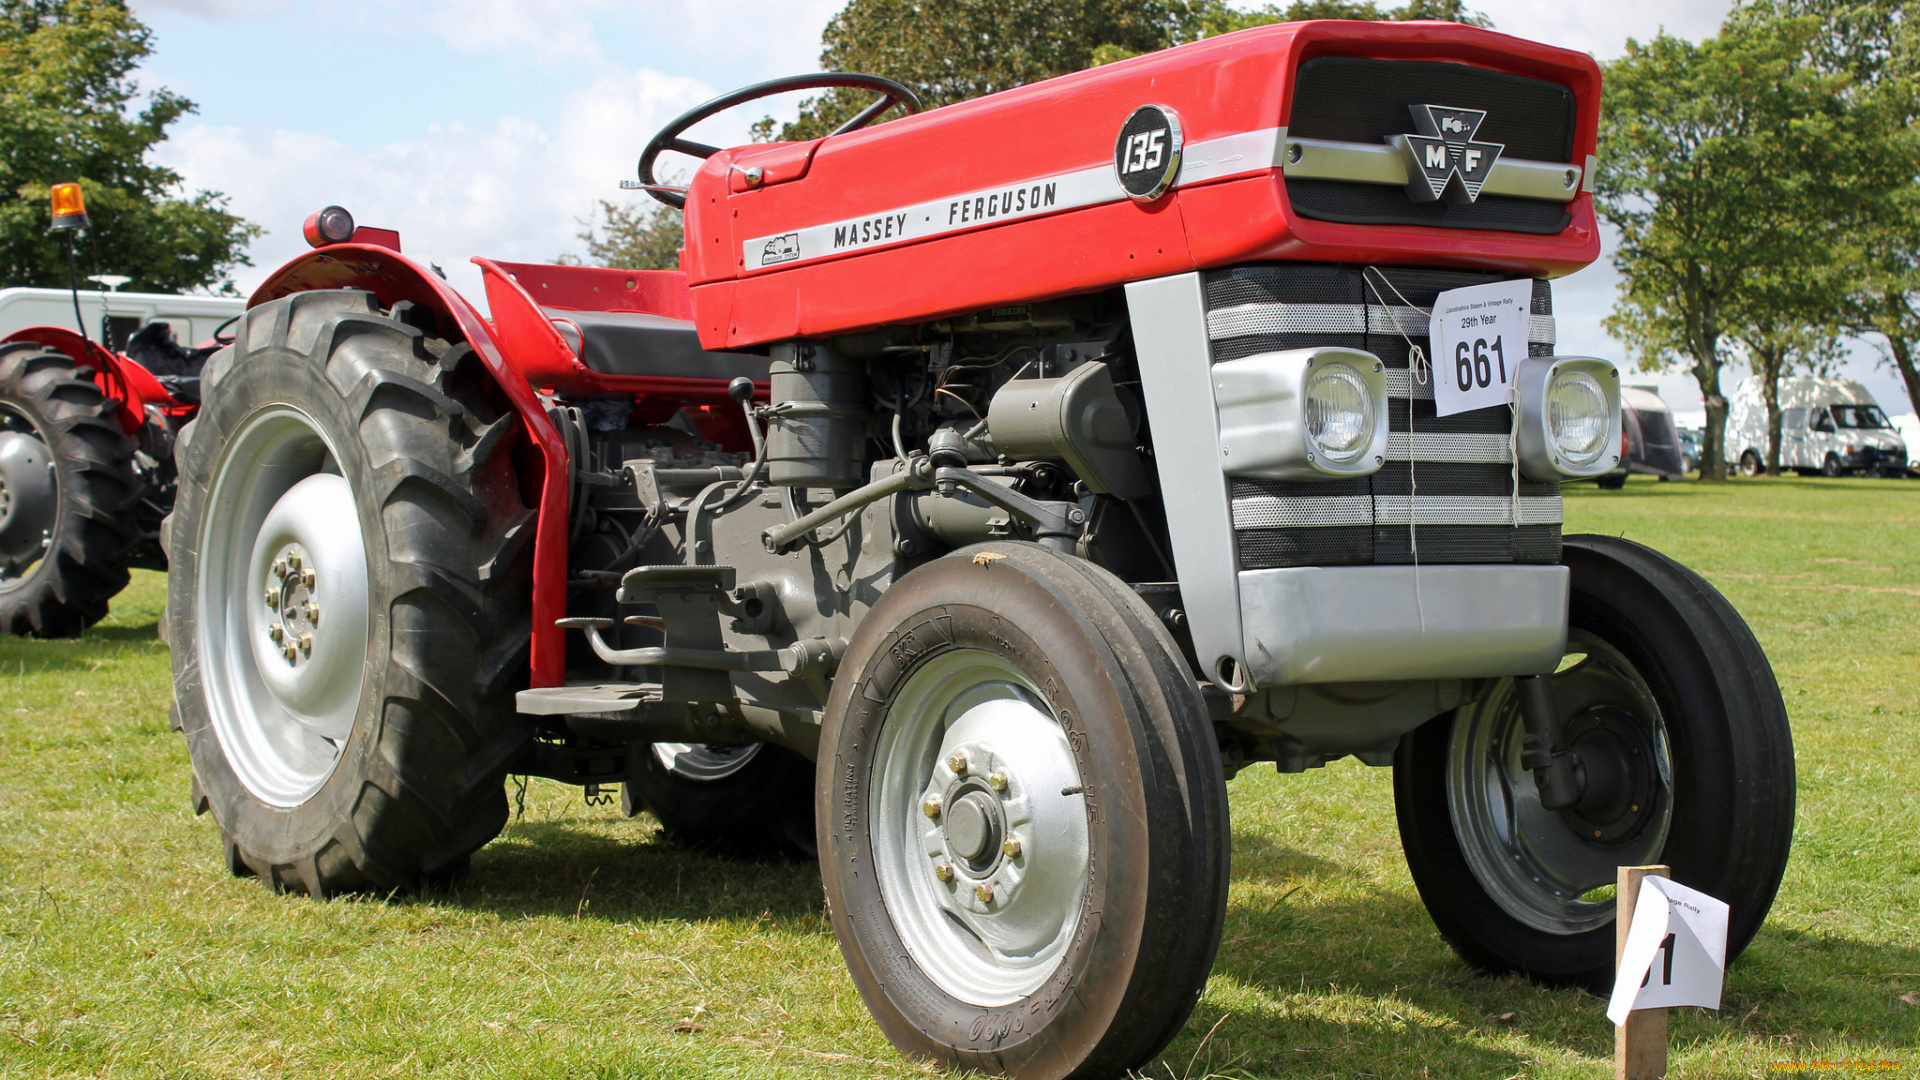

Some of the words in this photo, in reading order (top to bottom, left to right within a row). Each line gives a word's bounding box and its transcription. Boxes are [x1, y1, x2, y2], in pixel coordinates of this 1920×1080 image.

[1122, 127, 1166, 175] 135
[1425, 144, 1446, 169] M
[1465, 149, 1482, 172] F
[834, 213, 907, 248] MASSEY
[949, 182, 1057, 225] FERGUSON
[991, 306, 1027, 317] PERKINS
[1445, 304, 1470, 314] Lincolnshire
[1487, 299, 1502, 307] Vintage
[1461, 316, 1478, 328] 29th
[1480, 314, 1497, 325] Year
[1455, 334, 1507, 392] 661
[890, 633, 919, 667] BKT
[844, 763, 856, 807] RATING
[843, 810, 854, 832] PLY
[1684, 902, 1701, 914] Rally
